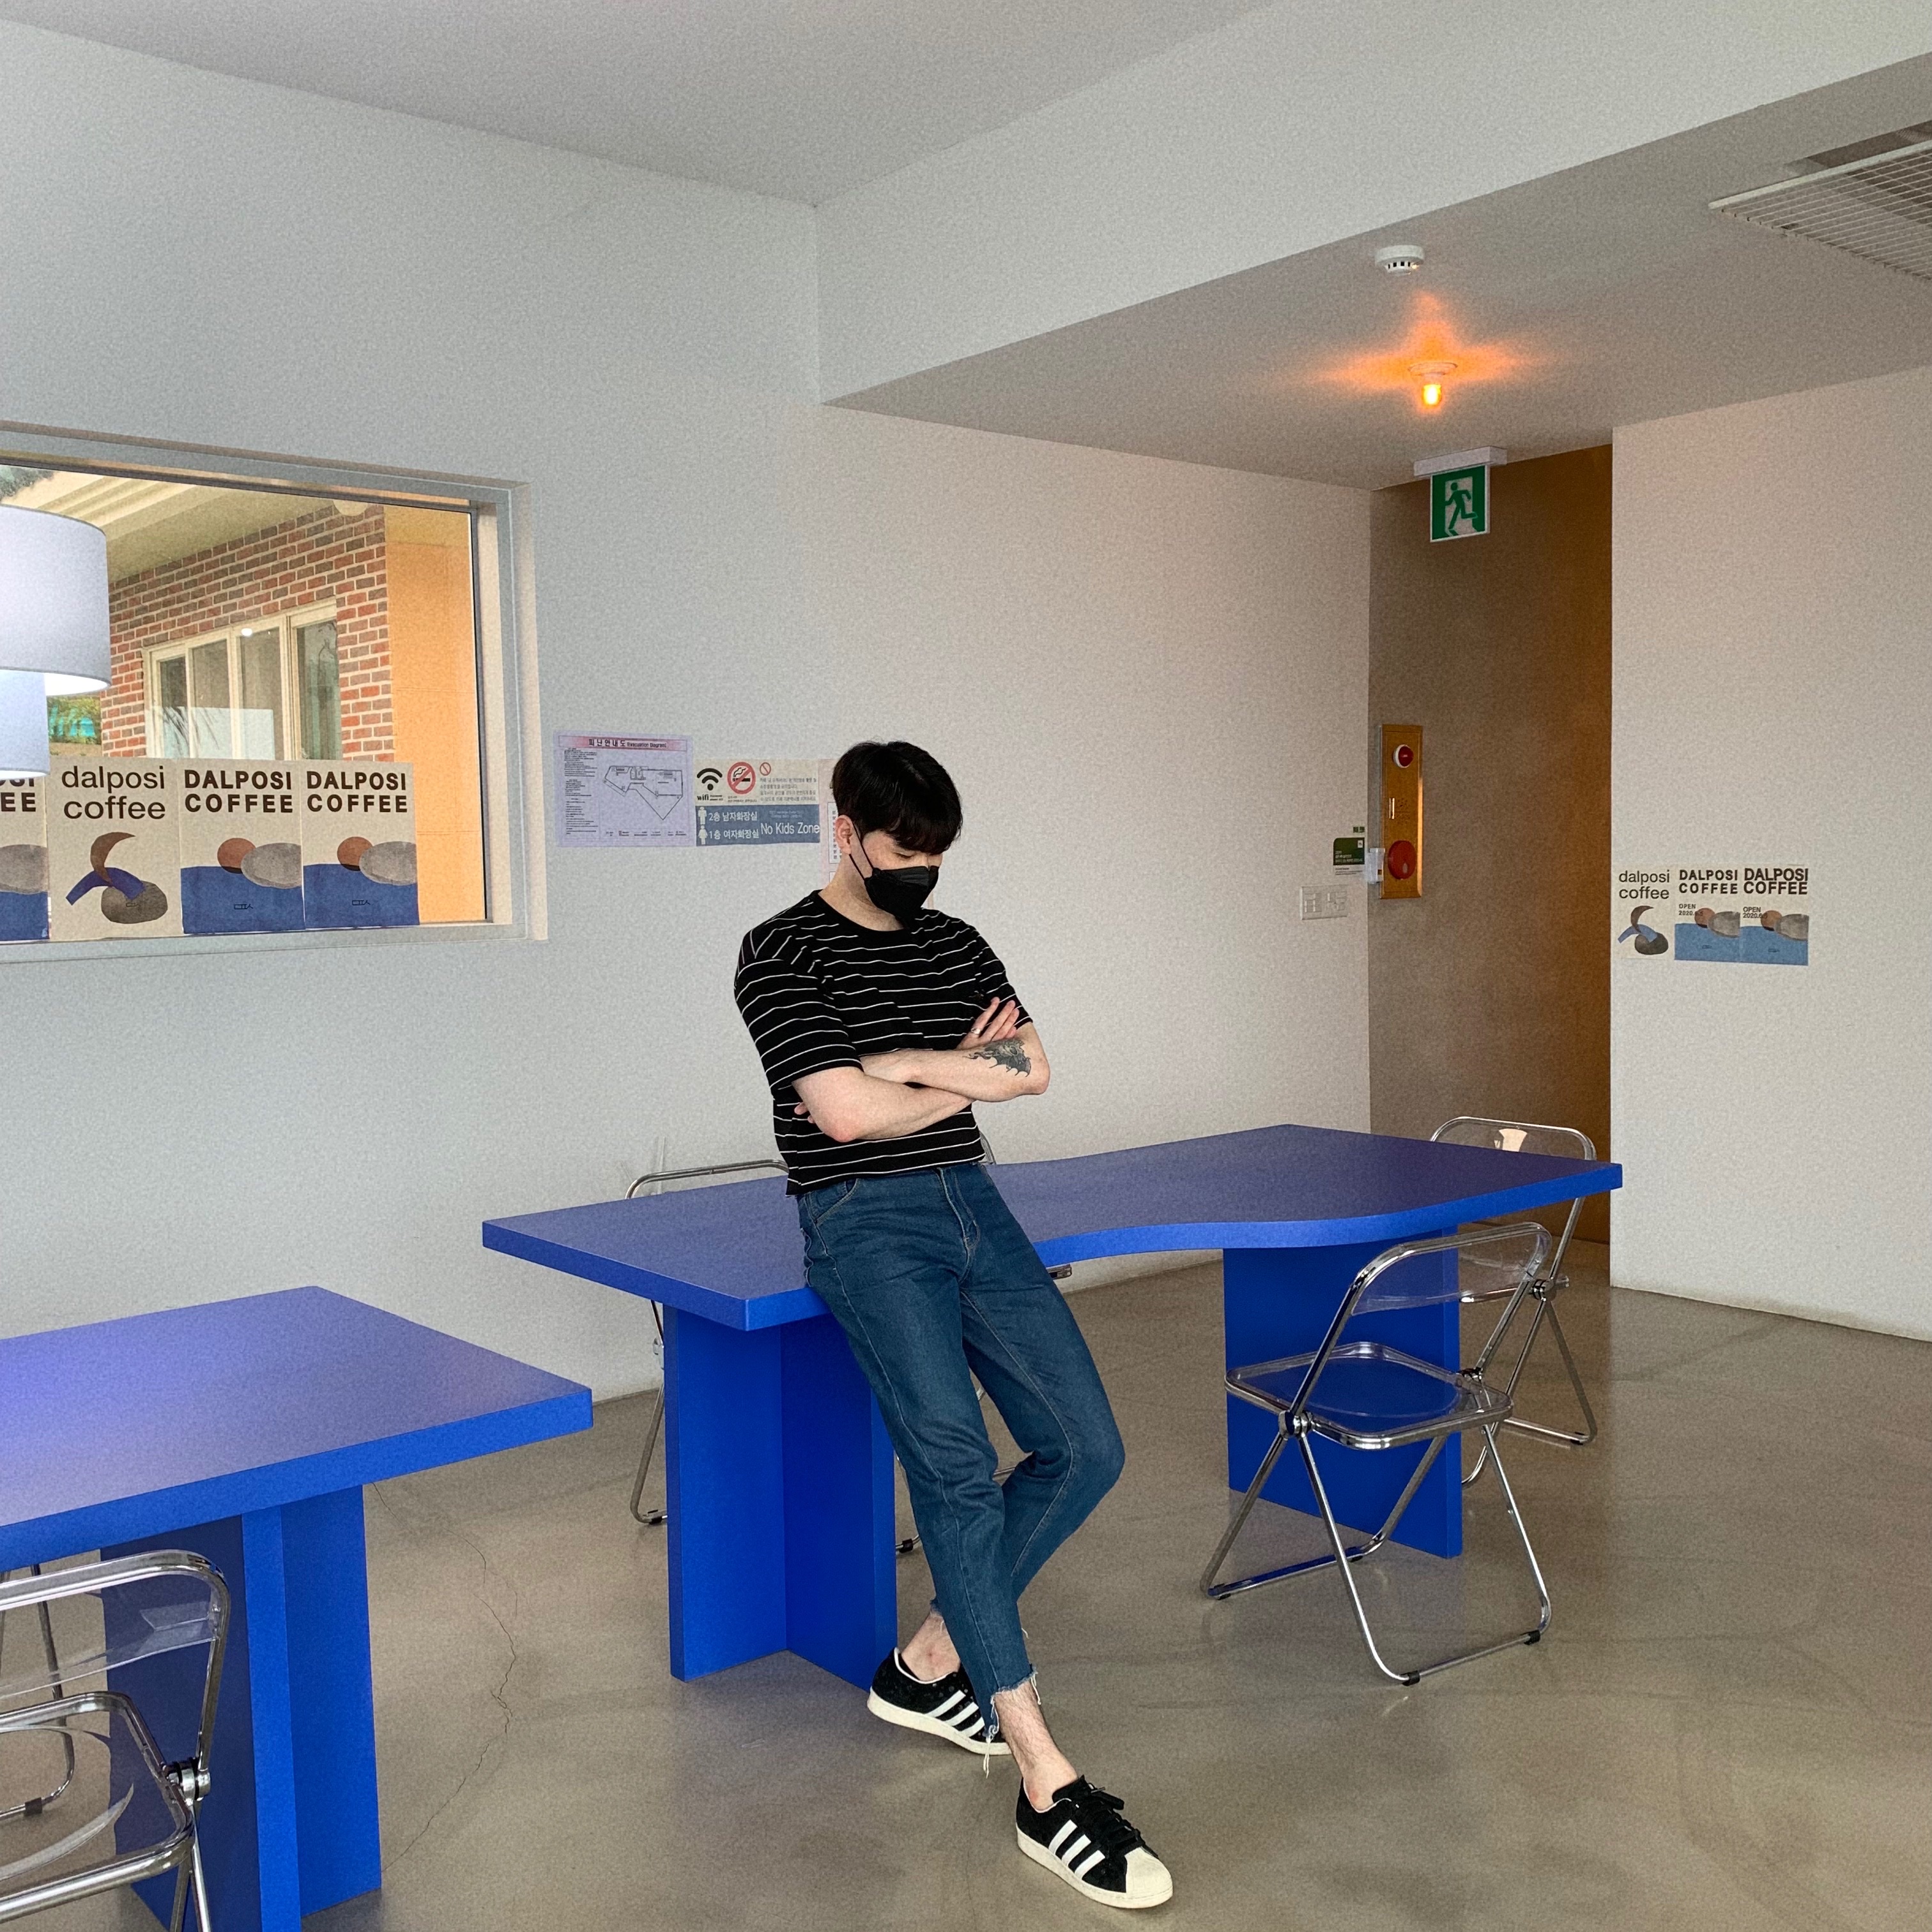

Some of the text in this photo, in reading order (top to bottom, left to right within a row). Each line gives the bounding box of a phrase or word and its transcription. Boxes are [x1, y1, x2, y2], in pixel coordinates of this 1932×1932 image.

[61, 765, 164, 793] dalposi
[184, 769, 291, 790] DALPOSI
[307, 770, 406, 790] DALPOSI
[64, 795, 165, 819] coffee
[185, 793, 293, 813] COFFEE
[307, 793, 407, 813] COFFEE
[709, 811, 758, 822] 2층 남자화장실
[709, 829, 760, 839] 1층 여자화장실
[760, 822, 820, 835] No Kids Zone
[1619, 870, 1669, 885] dalposi
[1679, 870, 1738, 880] DALPOSI
[1744, 868, 1809, 881] DALPOSI
[1619, 886, 1669, 899] coffee
[1679, 882, 1738, 894] COFFEE
[1744, 881, 1808, 894] COFFEE
